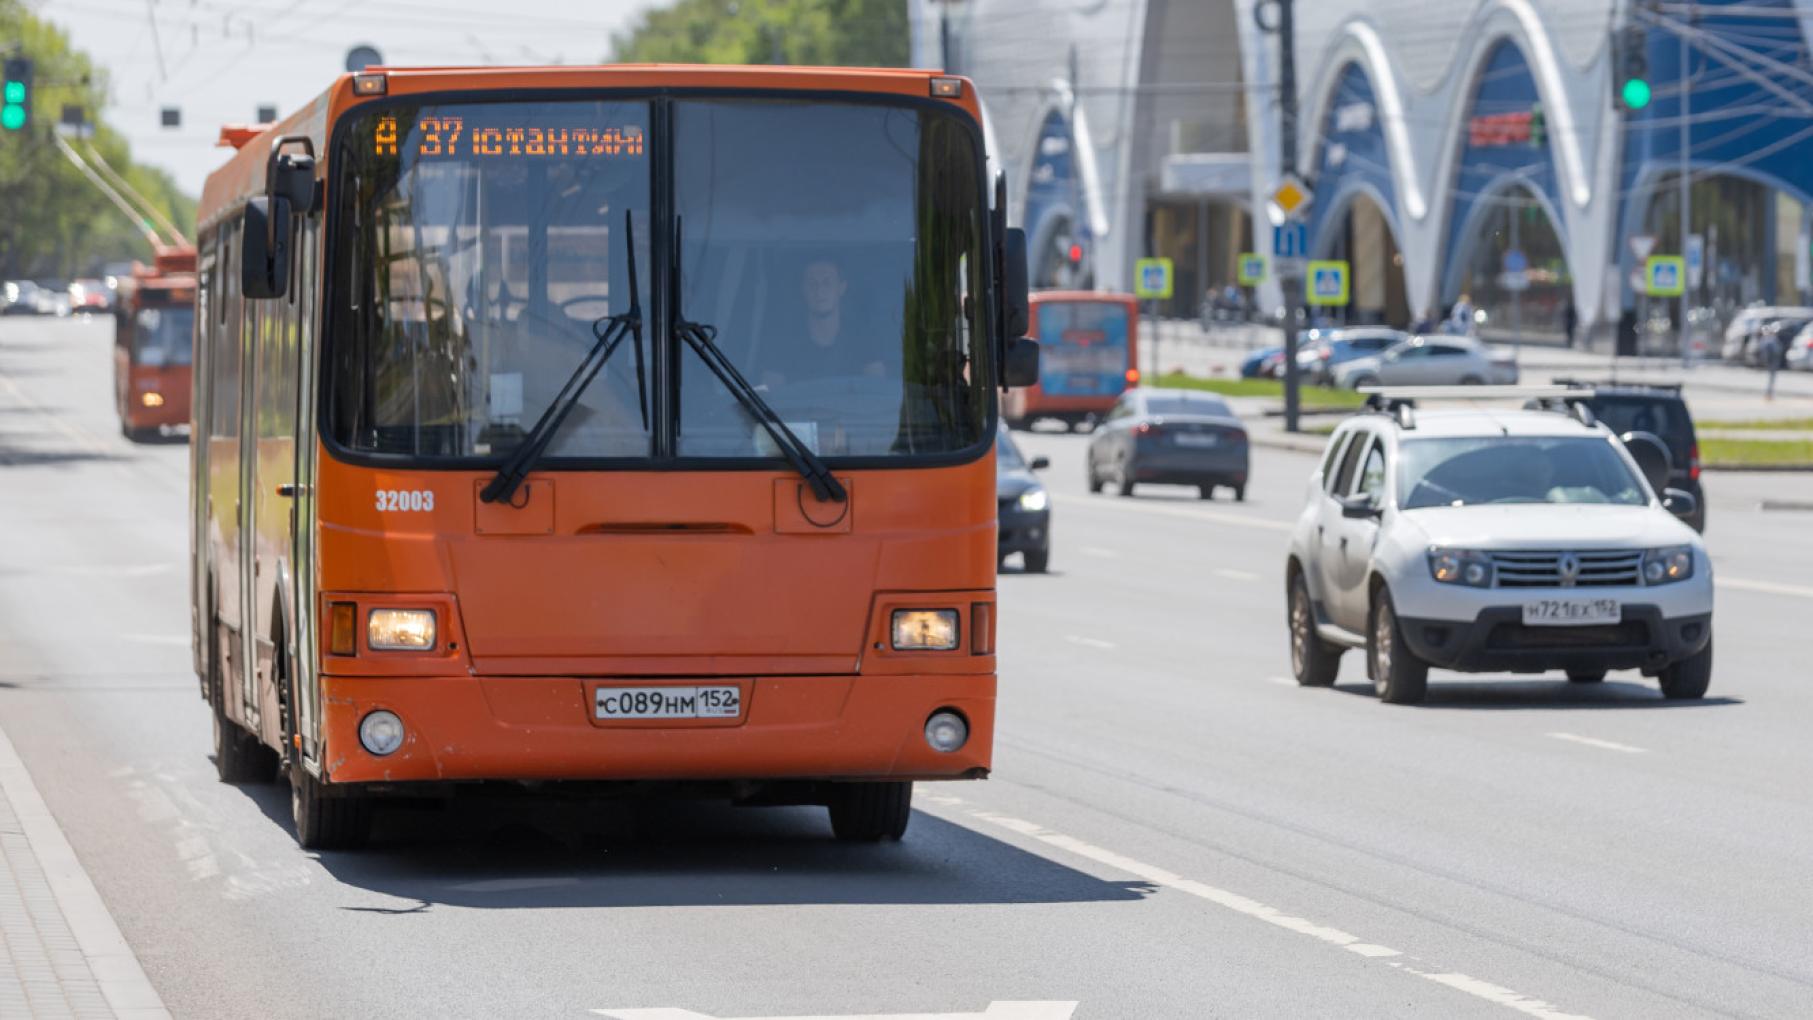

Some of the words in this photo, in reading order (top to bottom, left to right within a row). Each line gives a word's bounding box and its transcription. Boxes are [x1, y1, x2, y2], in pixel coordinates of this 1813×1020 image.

[375, 117, 397, 155] А
[420, 117, 463, 155] 37
[375, 490, 434, 511] 32003
[700, 690, 734, 707] 152
